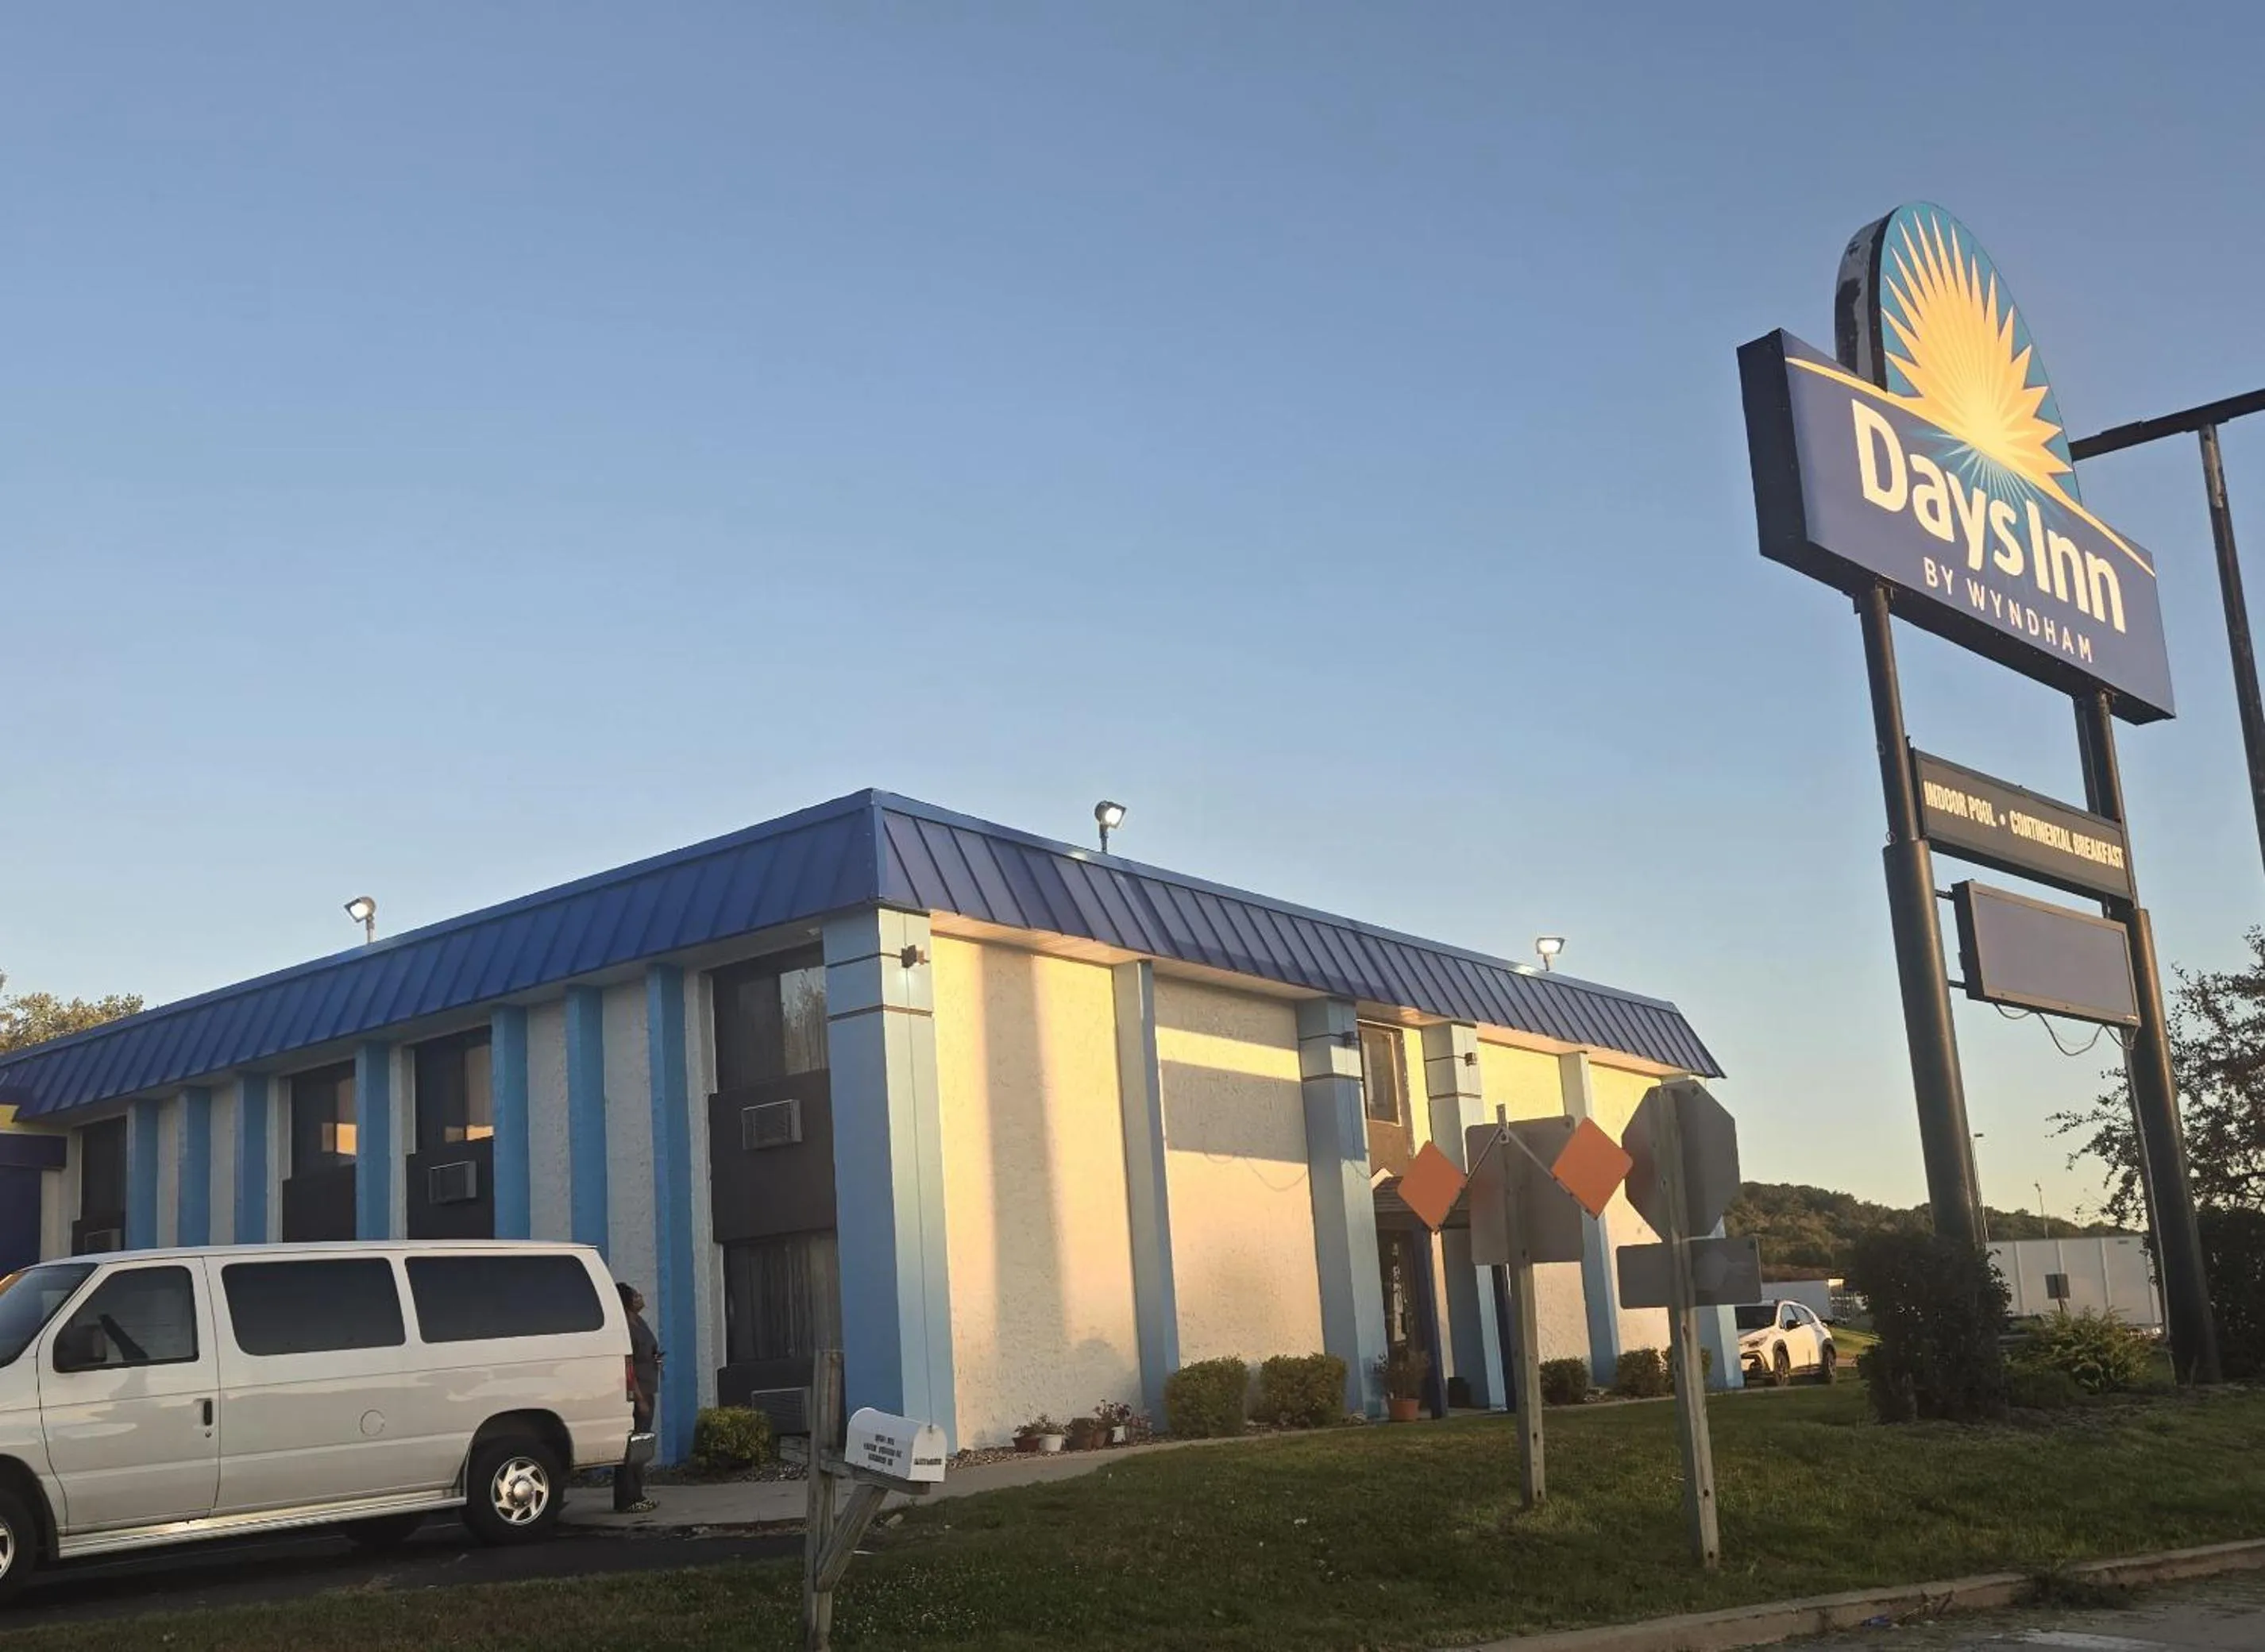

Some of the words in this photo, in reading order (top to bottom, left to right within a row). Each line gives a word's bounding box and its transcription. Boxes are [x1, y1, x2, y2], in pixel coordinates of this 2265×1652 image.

[1851, 399, 2023, 576] Days
[2027, 500, 2126, 634] Inn
[1924, 557, 1953, 595] BY
[1966, 577, 2093, 663] WYNDHAM
[1924, 780, 1968, 818] INDOOR
[1967, 795, 1997, 827] POOL
[2009, 810, 2074, 854] CONTINENTAL
[2073, 832, 2124, 869] BREAKFAST
